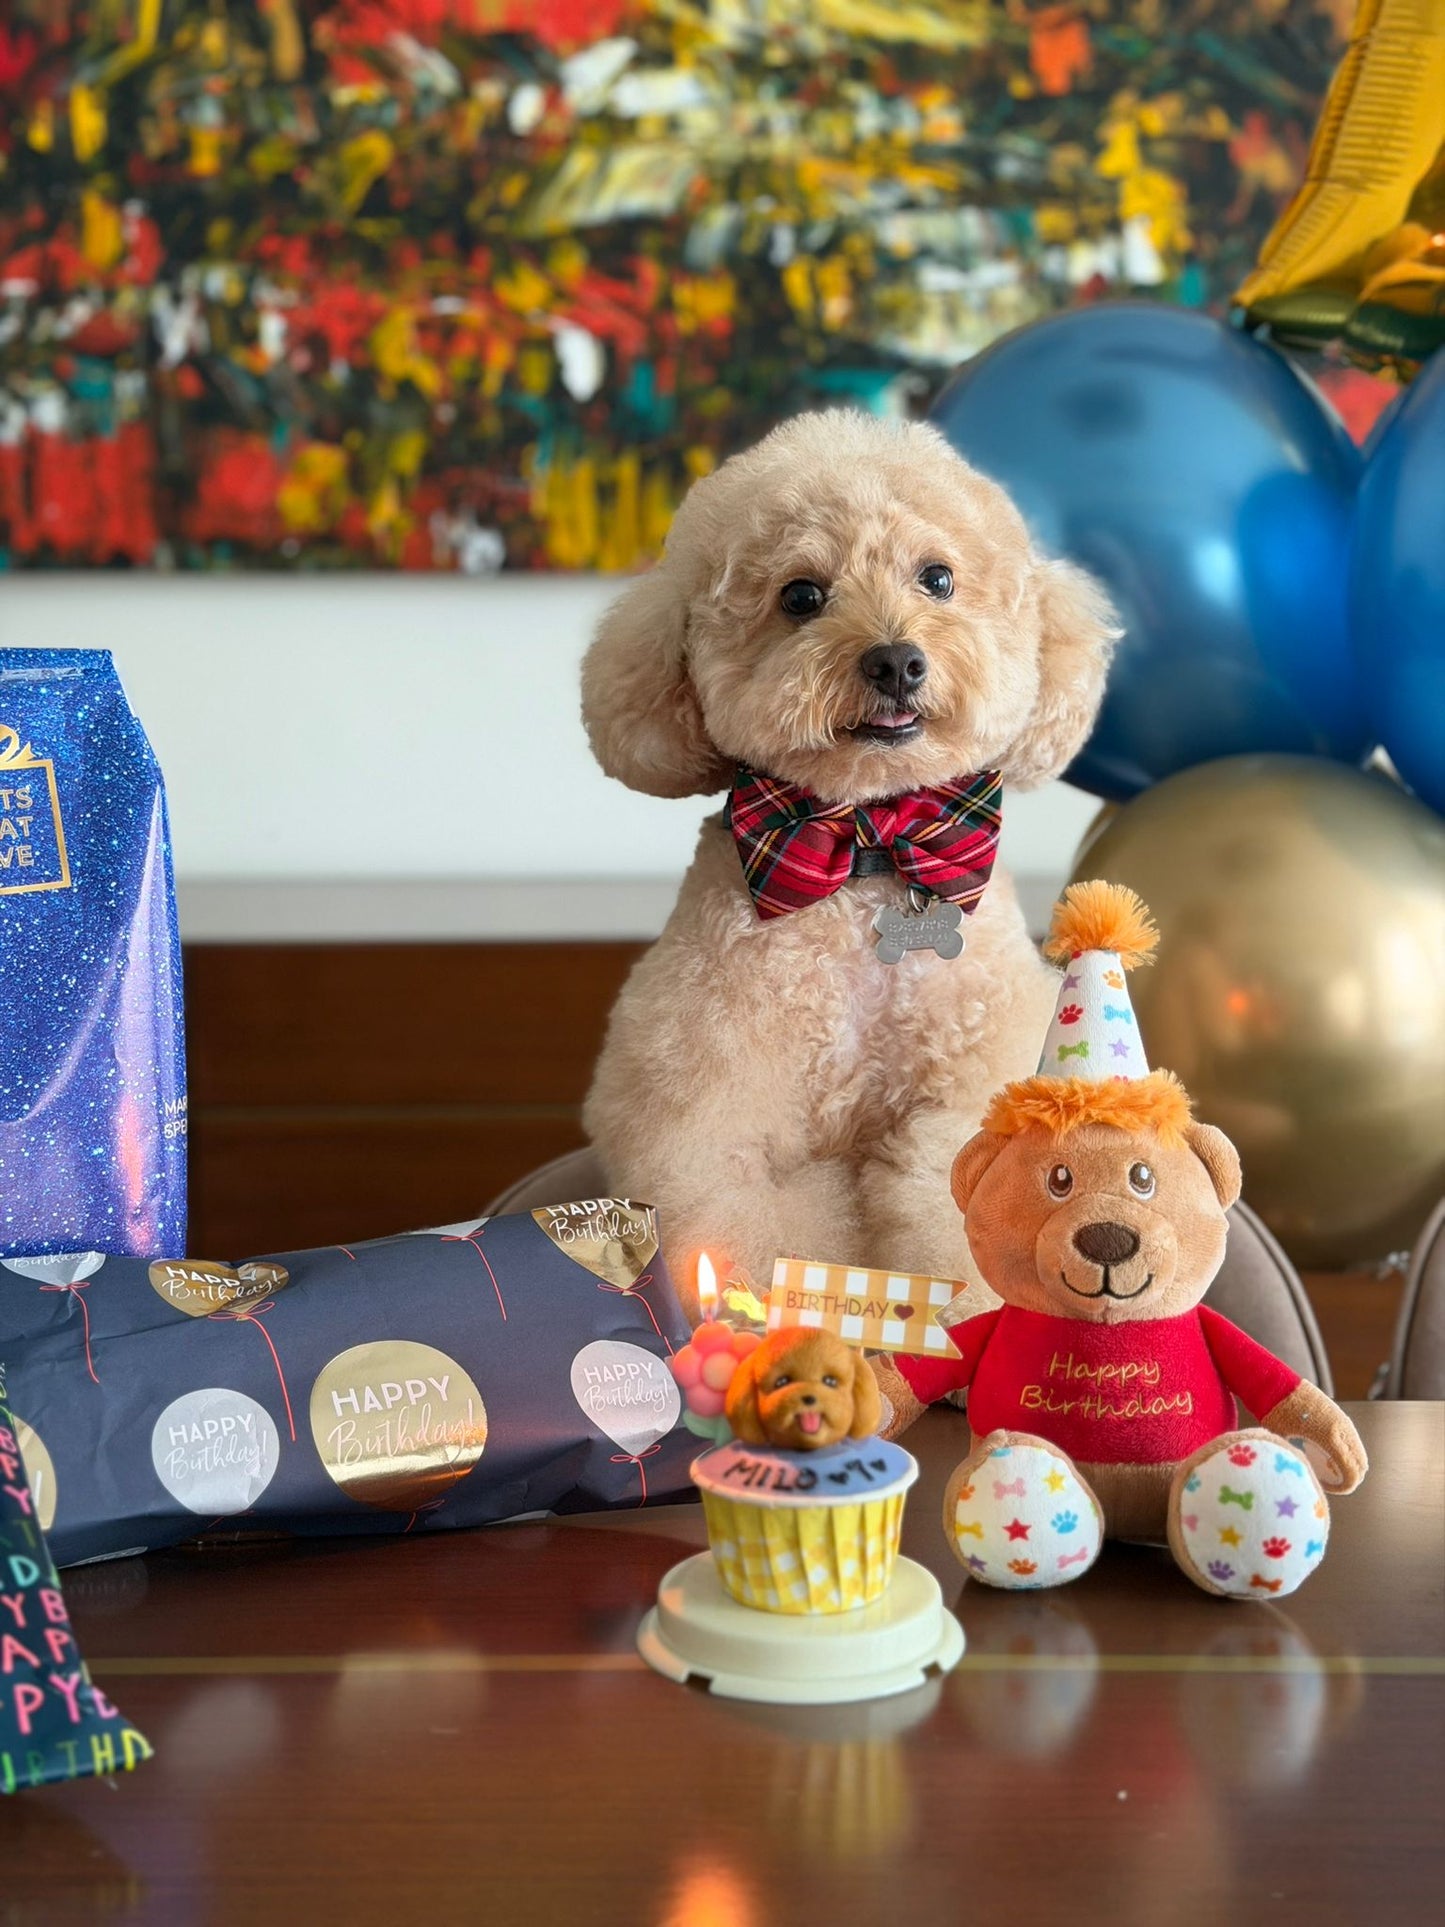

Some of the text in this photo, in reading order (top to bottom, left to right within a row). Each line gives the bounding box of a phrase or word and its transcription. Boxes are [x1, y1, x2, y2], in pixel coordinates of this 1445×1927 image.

[546, 1198, 630, 1217] HAPPY
[786, 1290, 889, 1320] BIRTHDAY
[584, 1362, 654, 1384] HAPPY
[1049, 1352, 1161, 1386] Happy
[332, 1375, 450, 1417] HAPPY
[1020, 1385, 1194, 1419] Birthday
[169, 1413, 253, 1446] HAPPY
[327, 1398, 476, 1466] Birthday!
[164, 1430, 268, 1479] Birthday!
[723, 1458, 819, 1491] MILO
